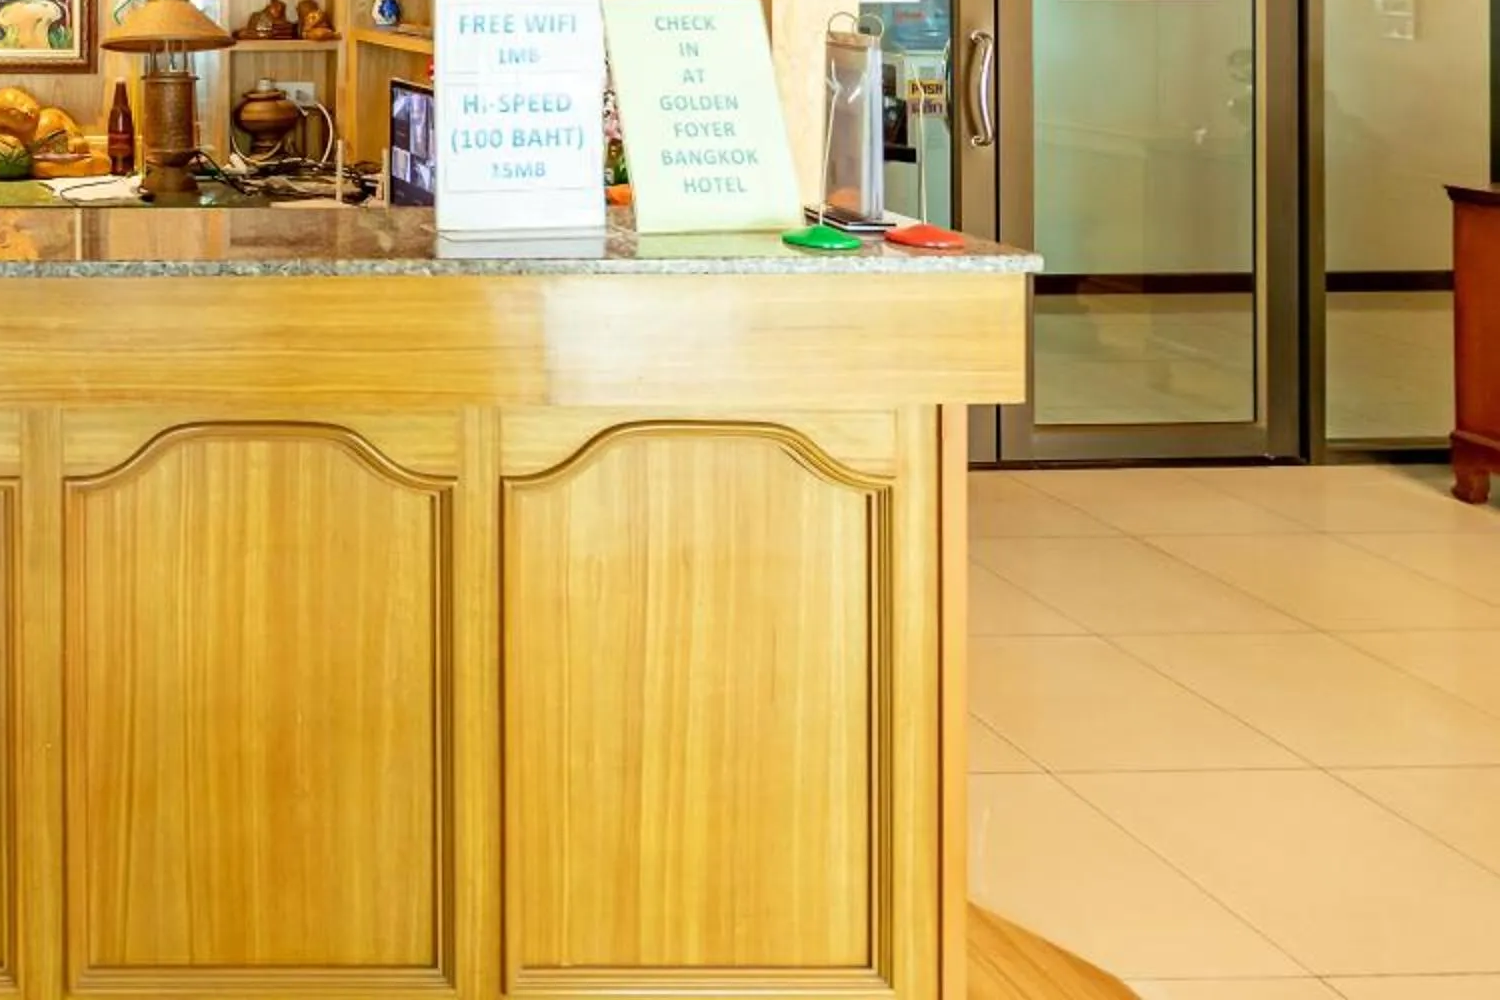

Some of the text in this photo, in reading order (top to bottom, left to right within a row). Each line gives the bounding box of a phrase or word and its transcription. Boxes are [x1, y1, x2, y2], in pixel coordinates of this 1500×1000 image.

[459, 13, 577, 34] FREE WIFI
[654, 15, 717, 31] CHECK
[498, 47, 541, 65] 1MB
[679, 41, 699, 57] IN
[683, 67, 705, 84] AT
[660, 95, 739, 111] GOLDEN
[674, 121, 736, 137] FOYER
[451, 126, 584, 152] (100 BAHT)
[661, 148, 758, 166] BANGKOK
[684, 176, 748, 193] HOTEL
